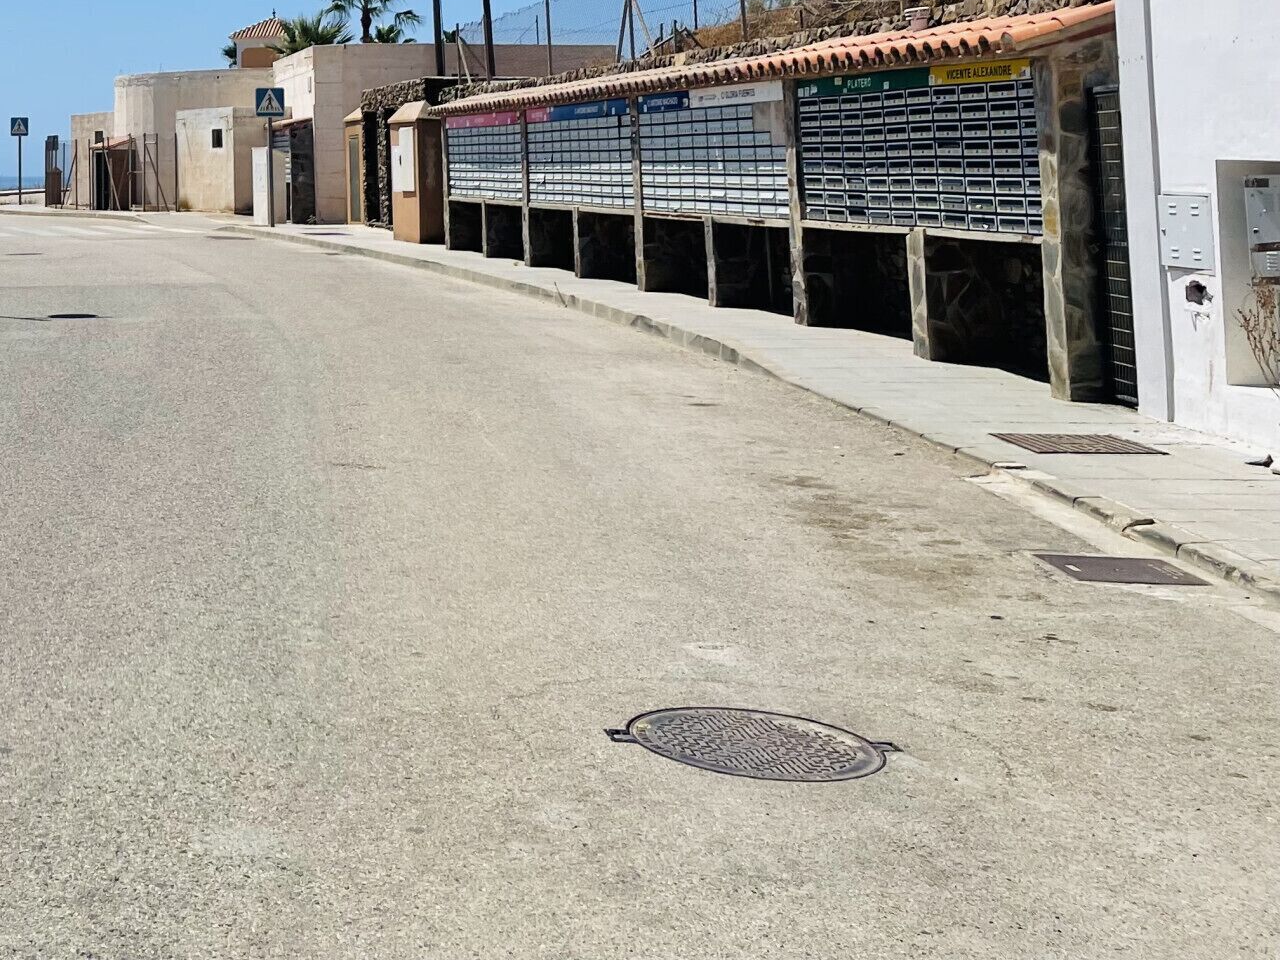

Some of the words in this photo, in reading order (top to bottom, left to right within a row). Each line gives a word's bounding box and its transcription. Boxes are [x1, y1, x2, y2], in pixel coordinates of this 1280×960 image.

[946, 68, 971, 80] VICENTE
[972, 65, 1013, 78] ALEXANDRE
[847, 77, 872, 89] PLATERO
